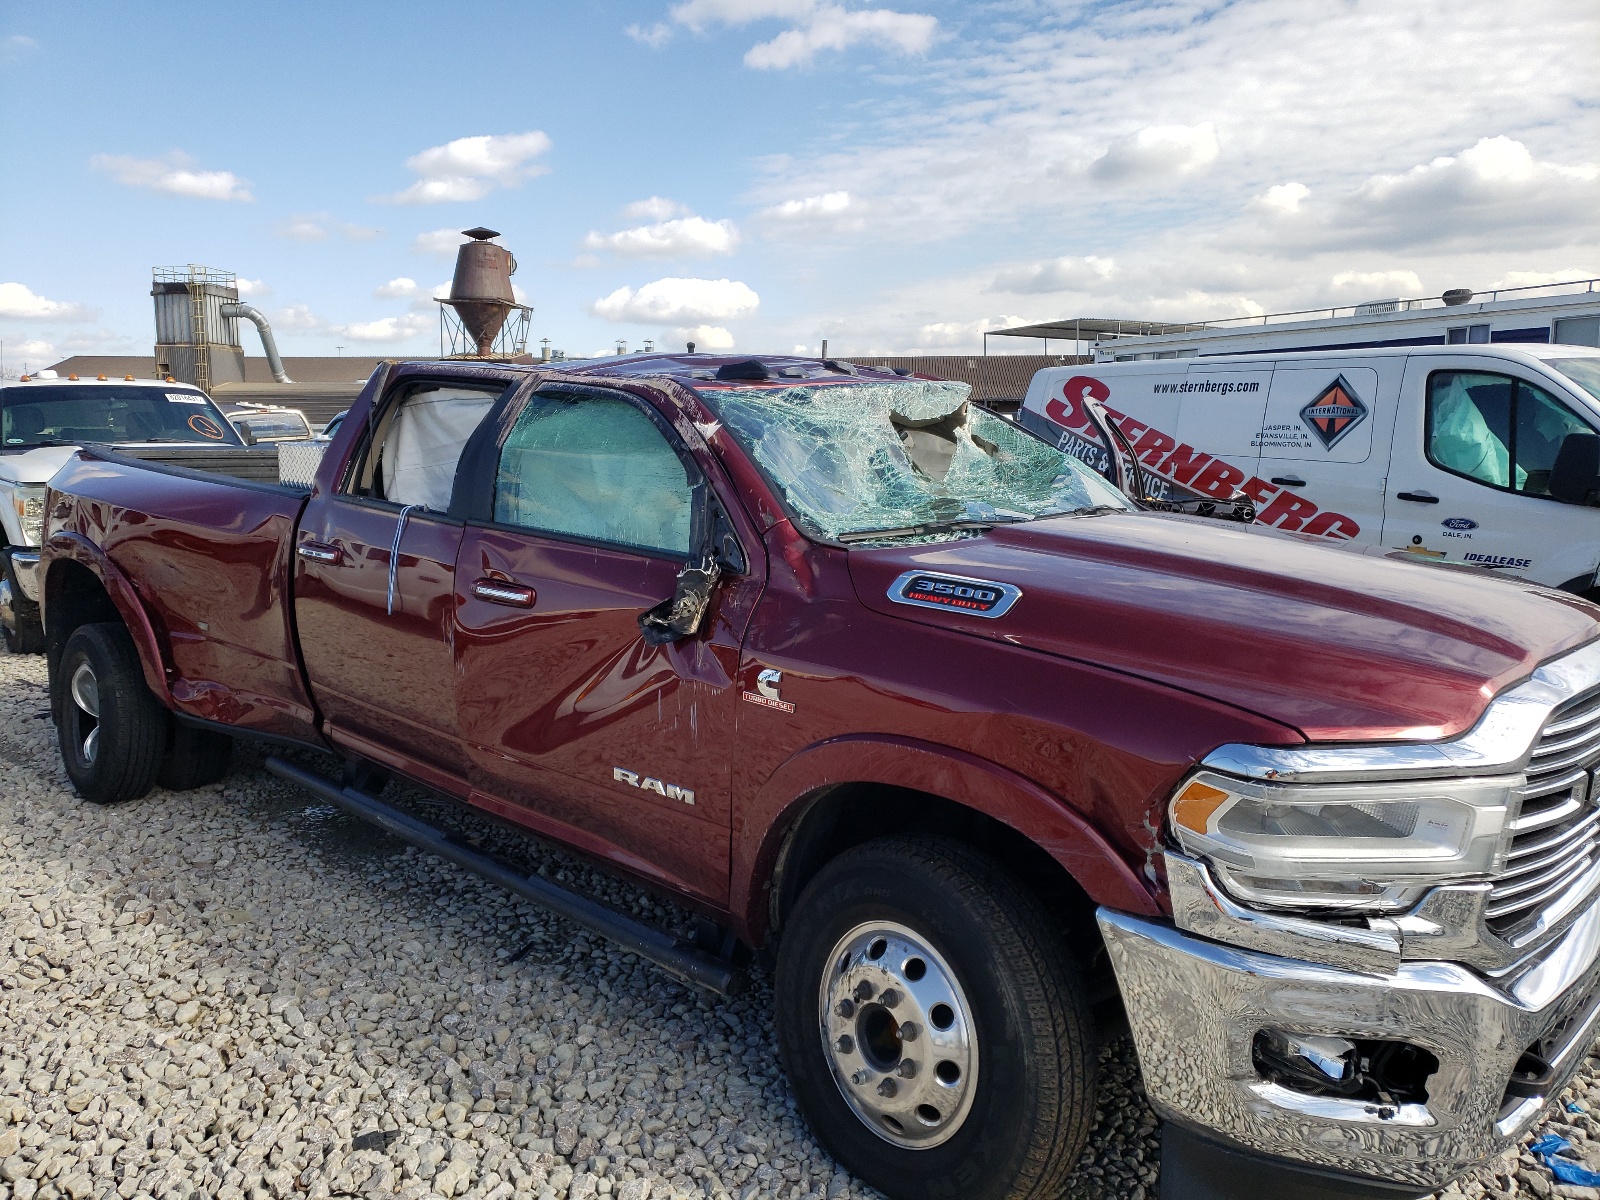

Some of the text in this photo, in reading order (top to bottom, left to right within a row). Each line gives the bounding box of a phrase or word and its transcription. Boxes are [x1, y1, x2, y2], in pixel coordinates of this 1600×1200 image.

[1153, 380, 1260, 396] www.sternbergs.com
[1308, 406, 1359, 415] INTERNATIONAL
[1255, 432, 1299, 440] EVANSVILLE,
[1263, 424, 1292, 432] JASPER,
[1058, 431, 1098, 466] PARTS
[1250, 440, 1303, 448] BLOOMINGTON,
[1449, 518, 1471, 530] Ford
[1442, 531, 1463, 539] DALE,
[1463, 552, 1532, 568] IDEALEASE
[915, 579, 997, 602] 3500
[907, 592, 991, 610] HEAVY DUTY
[744, 693, 793, 711] TURBO DIESEL
[613, 766, 695, 806] RAM
